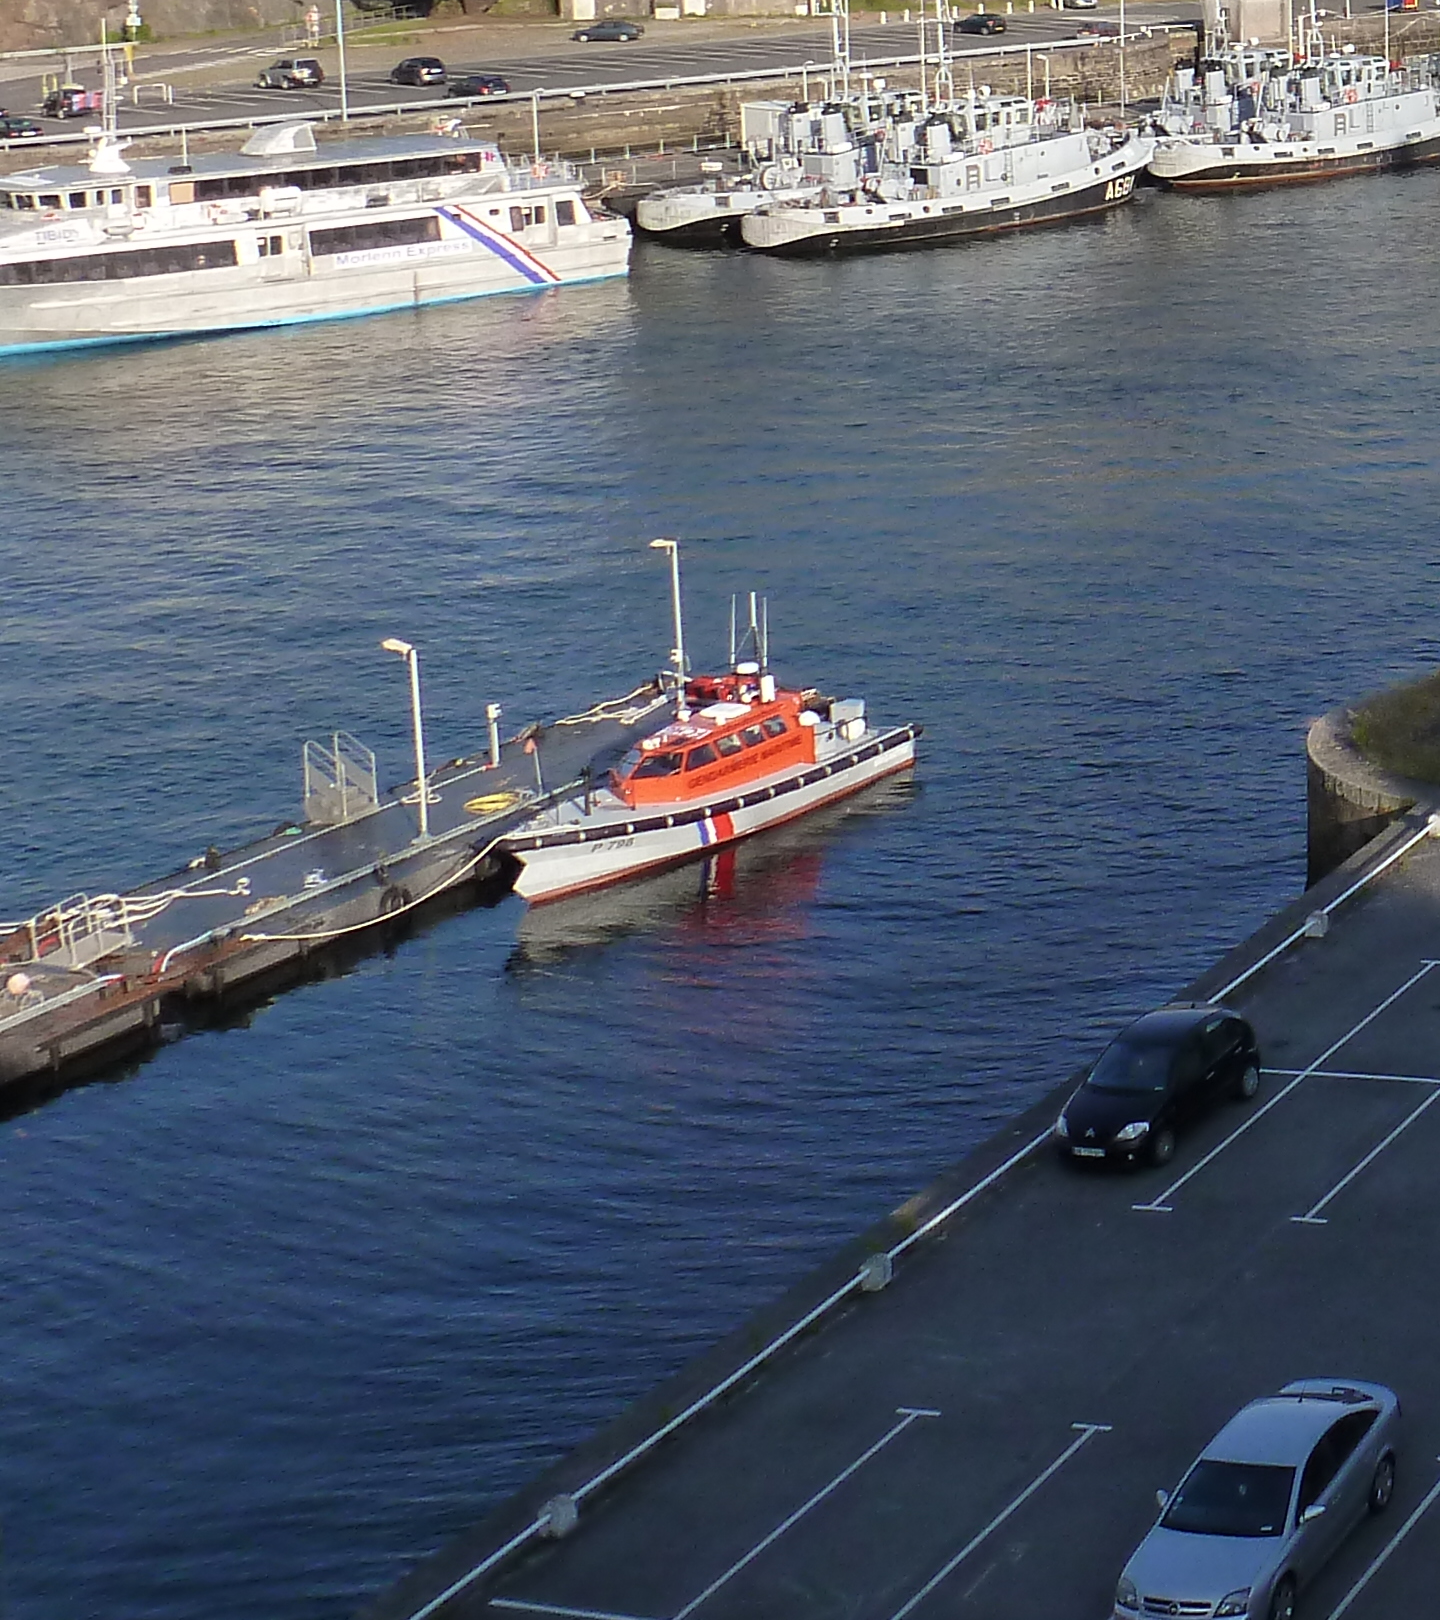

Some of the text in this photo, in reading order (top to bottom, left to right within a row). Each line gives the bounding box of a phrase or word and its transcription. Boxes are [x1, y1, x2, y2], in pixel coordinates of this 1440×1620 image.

[335, 240, 471, 266] Morlenn Express
[590, 842, 604, 854] P
